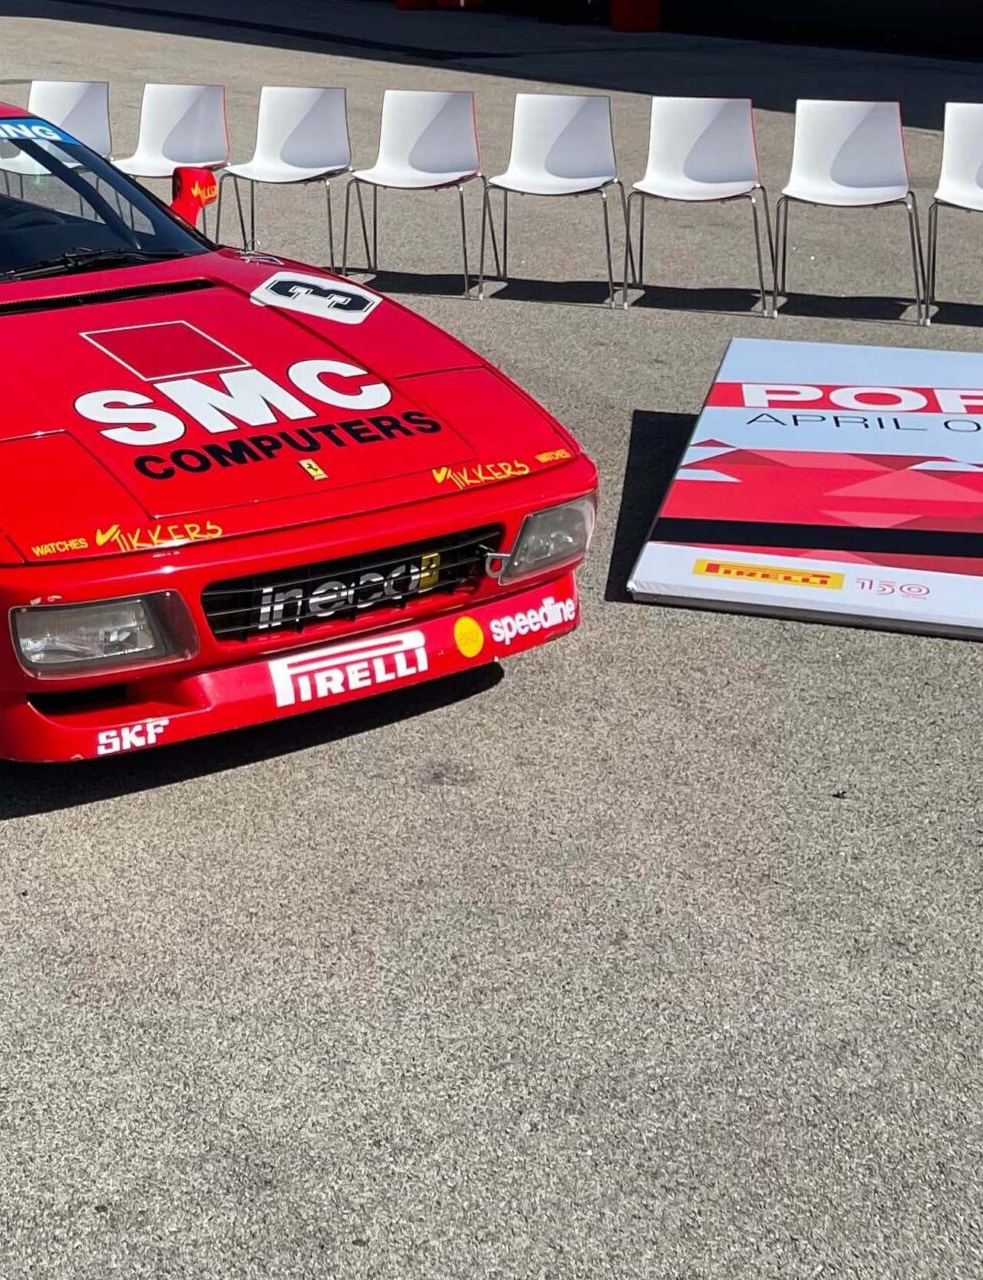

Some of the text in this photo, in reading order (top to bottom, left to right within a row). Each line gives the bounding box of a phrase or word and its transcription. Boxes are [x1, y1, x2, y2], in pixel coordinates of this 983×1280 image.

[265, 279, 376, 312] 3
[73, 359, 393, 446] SMC
[746, 413, 929, 431] APRIL
[134, 410, 443, 480] COMPUTERS
[447, 460, 531, 491] TIKKERS
[32, 521, 223, 558] WATCHES TIKKERS
[490, 597, 576, 646] speedline
[268, 630, 429, 708] PIRELLI
[97, 718, 170, 755] SKF
